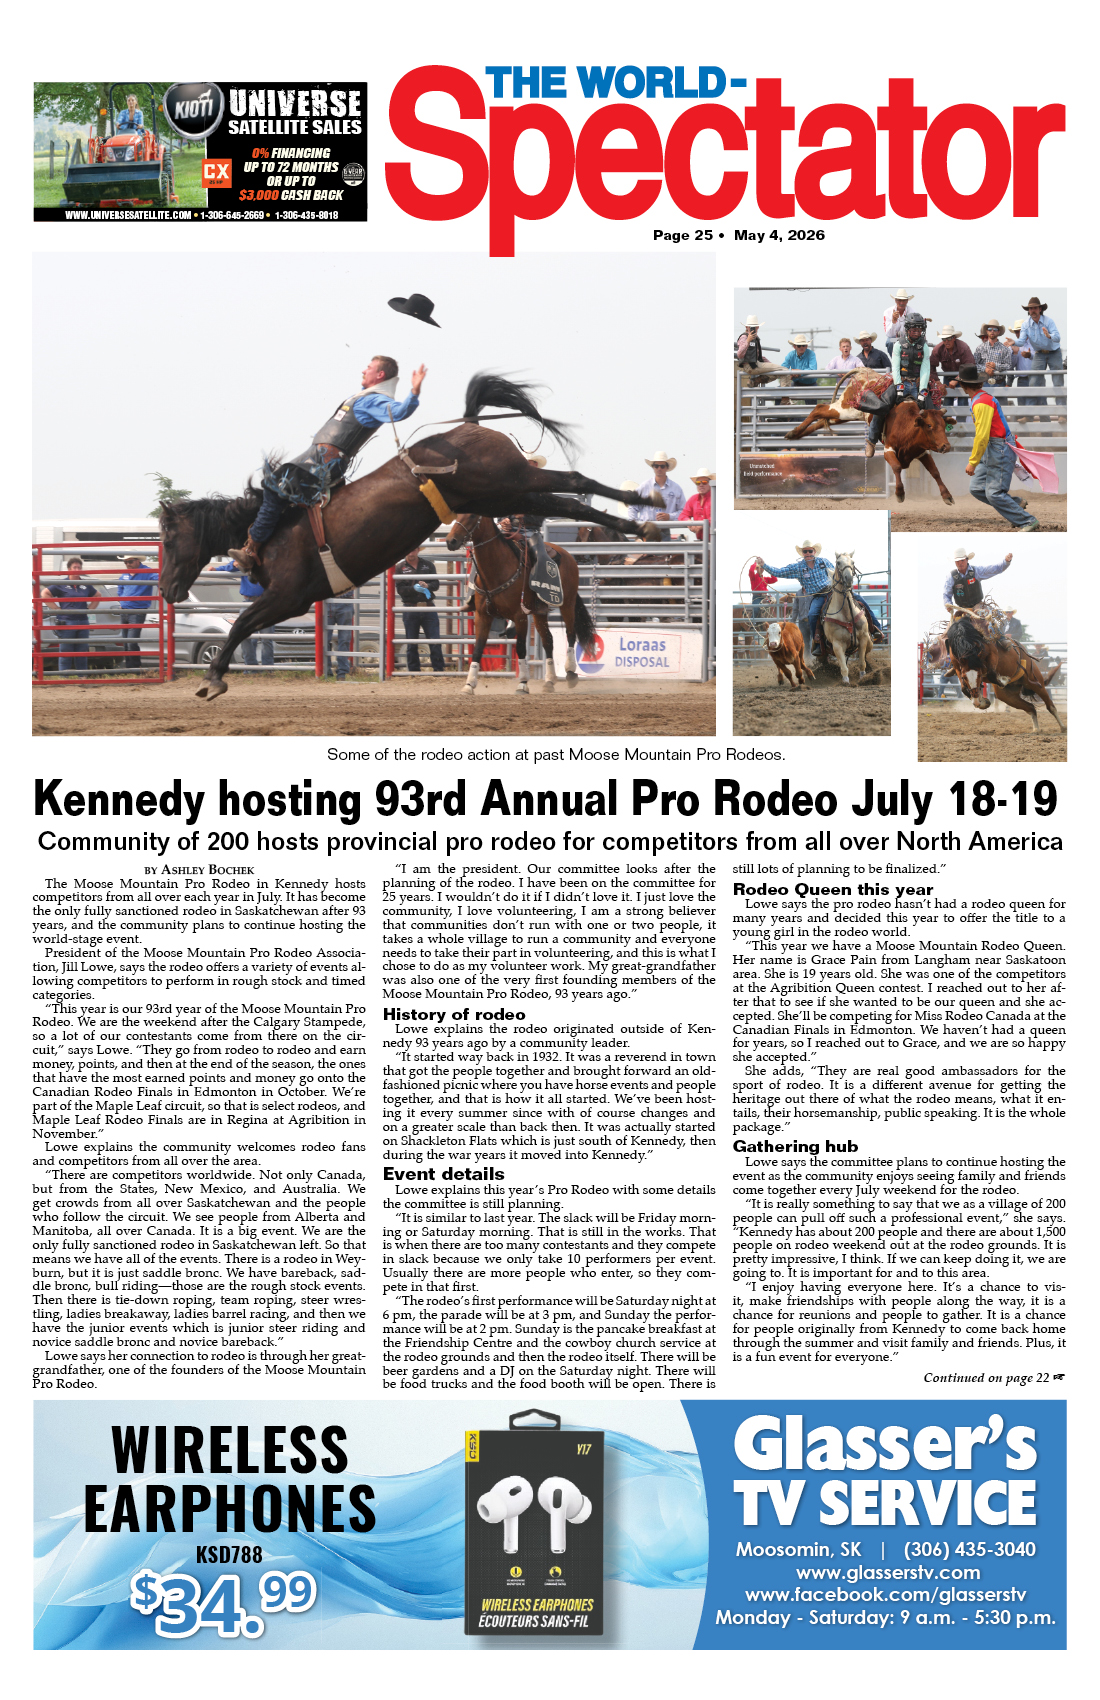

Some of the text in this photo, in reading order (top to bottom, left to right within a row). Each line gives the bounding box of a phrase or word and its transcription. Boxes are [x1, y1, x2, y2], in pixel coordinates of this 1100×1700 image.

[486, 66, 746, 98] THE WORLD-
[174, 99, 214, 120] KIOTI
[229, 89, 361, 117] UNIVERSE
[229, 120, 362, 134] SATELLITE SALES
[252, 148, 331, 158] 0% FINANCING
[244, 162, 339, 172] UP TO 72 MONTHS
[385, 65, 1065, 257] Spectator
[204, 163, 230, 179] CX
[267, 176, 316, 186] OR UP TO
[239, 189, 344, 201] $3,000 CASH BACK
[65, 211, 191, 219] WWW.UNIVERSESATELLITE.COM
[201, 211, 264, 219] 1-306-645-2669
[275, 211, 338, 219] 1-306-435-8018
[654, 230, 713, 243] Page 25
[735, 230, 825, 243] May 4, 2026
[619, 637, 666, 652] Loraas
[615, 656, 670, 668] DISPOSAL
[328, 748, 785, 764] Some of the rodeo action at past Moose Mountain Pro Rodeos.
[35, 779, 1057, 825] Kennedy hosting 93rd Annual Pro Rodeo July 18-19
[38, 831, 1063, 856] Community of 200 hosts provincial pro rodeo for competitors from all over North America
[45, 878, 366, 891] The Moose Mountain Pro Rodeo in Kennedy hosts
[734, 883, 934, 899] Rodeo Queen this year
[733, 926, 910, 940] young girl in the rodeo world.
[384, 1008, 525, 1023] History of rodeo
[383, 1038, 412, 1051] nedy
[416, 1038, 429, 1047] 93
[432, 1041, 463, 1051] years
[467, 1041, 488, 1051] ago
[492, 1038, 506, 1051] by
[520, 1038, 588, 1051] community
[591, 1038, 630, 1047] leader.
[733, 1140, 858, 1155] Gathering hub
[384, 1167, 504, 1180] Event details
[383, 1198, 563, 1212] the committee is still planning.
[33, 1379, 97, 1388] Pro Rodeo.
[924, 1373, 985, 1382] Continued
[1006, 1376, 1033, 1386] page
[1036, 1373, 1049, 1382] 22
[112, 1426, 347, 1473] WIRELESS
[577, 1444, 592, 1455] Y17
[86, 1485, 375, 1532] EARPHONES
[734, 1480, 1035, 1525] TV SERVICE
[197, 1546, 262, 1563] KSD788
[737, 1542, 861, 1558] Moosomin, SK
[905, 1542, 1035, 1560] (306) 435-3040
[797, 1565, 980, 1582] www.glasserstv.com
[746, 1587, 1026, 1605] www.facebook.com/glasserstv
[482, 1599, 594, 1611] WIRELESS EARPHONES
[479, 1612, 588, 1627] ÉCOUTEURS SANS-FIL
[716, 1610, 790, 1628] Monday
[810, 1610, 893, 1628] Saturday:
[901, 1610, 909, 1624] 9
[916, 1614, 954, 1624] a.m.
[975, 1610, 1010, 1624] 5:30
[1017, 1614, 1055, 1628] p.m.
